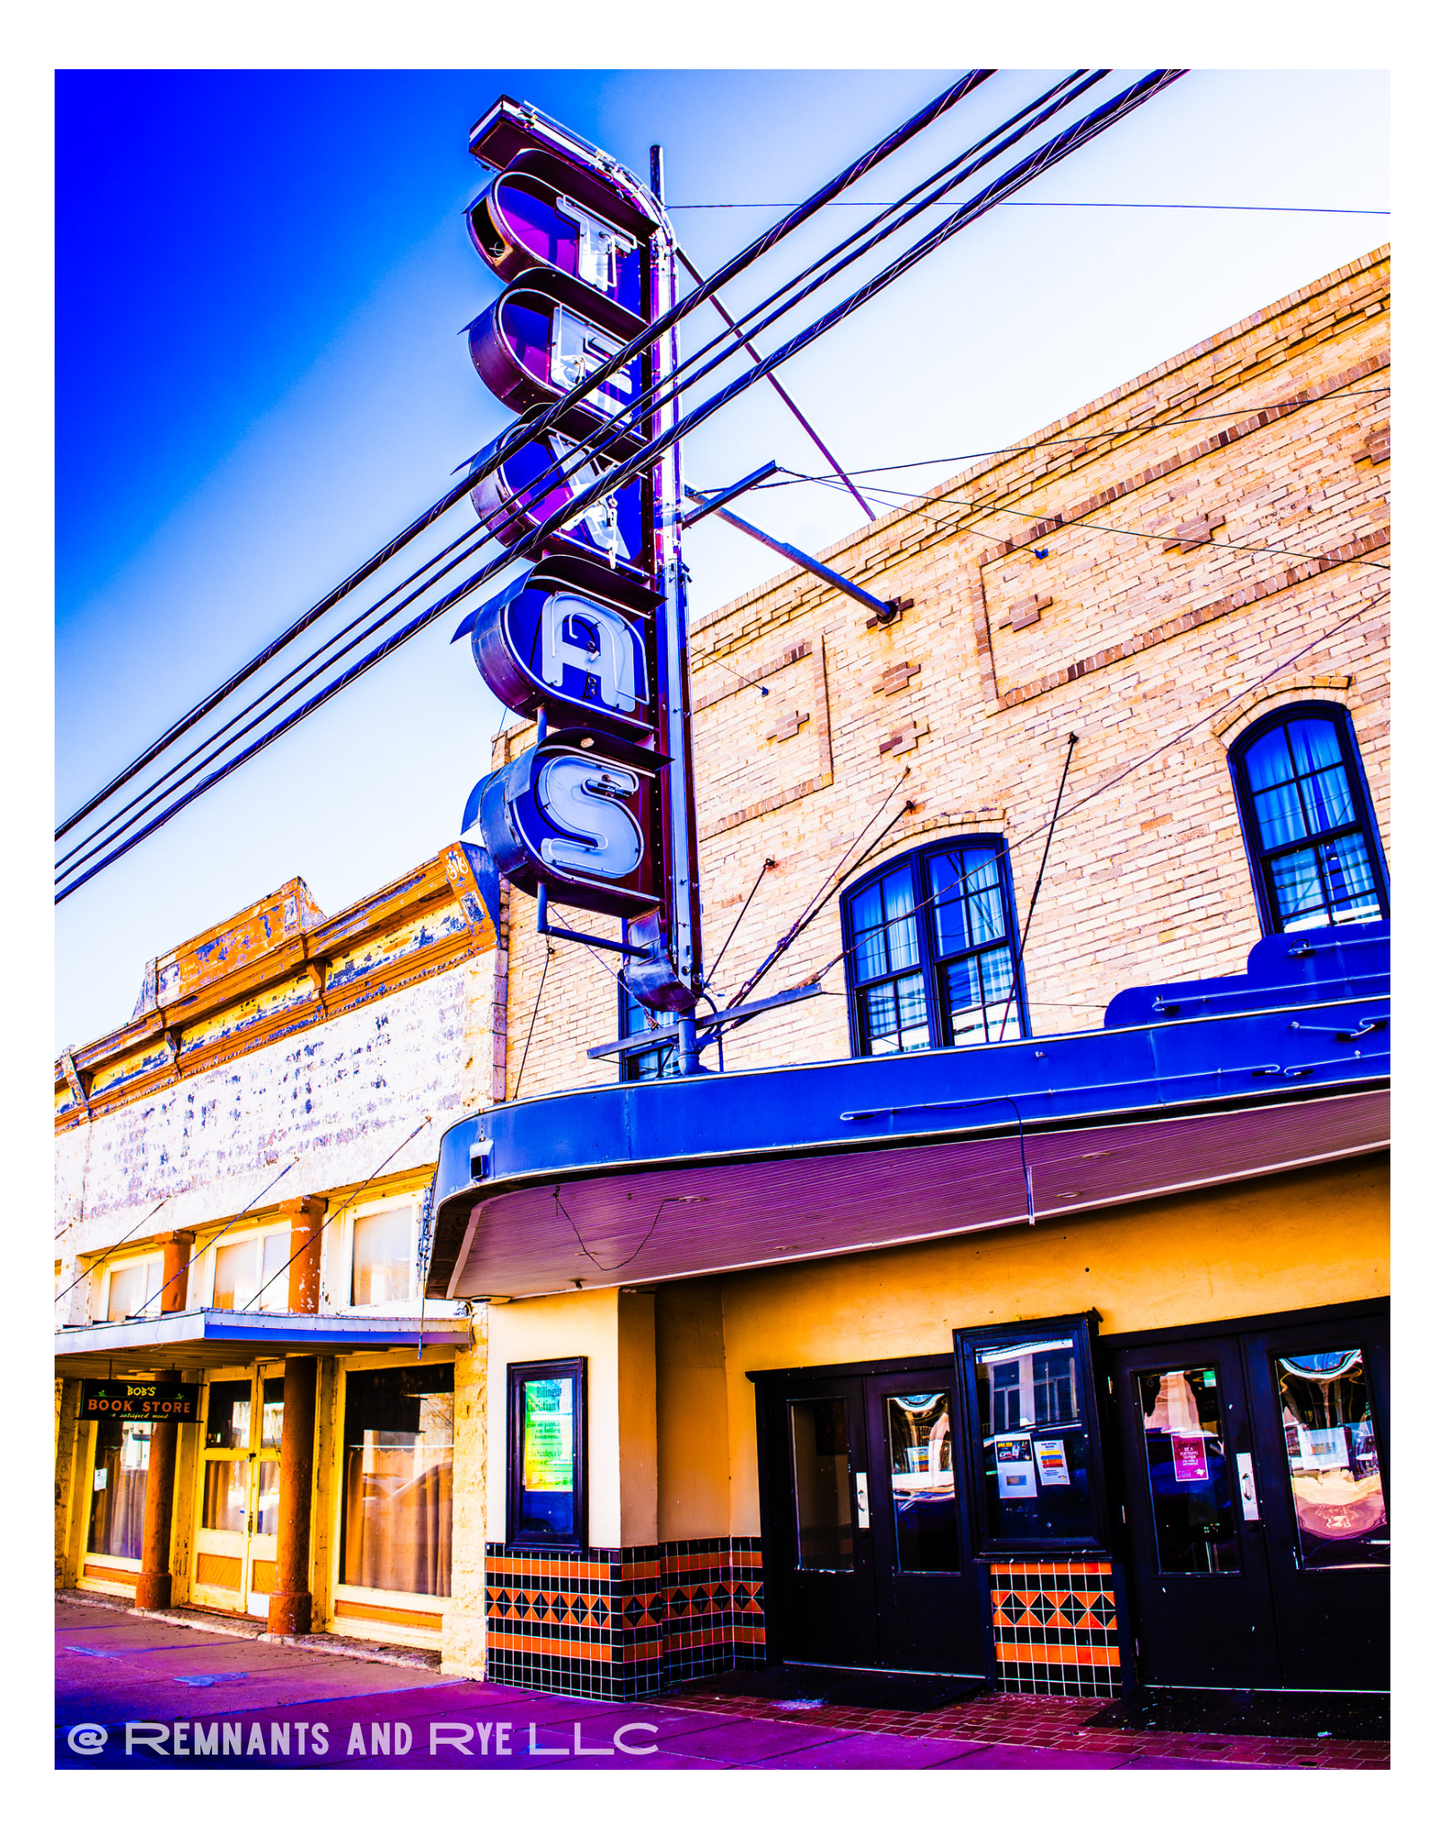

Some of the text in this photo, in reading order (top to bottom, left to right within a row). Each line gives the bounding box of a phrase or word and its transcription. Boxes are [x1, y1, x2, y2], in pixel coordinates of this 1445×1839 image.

[539, 193, 649, 879] TEXAS
[126, 1384, 156, 1397] BOB'S
[88, 1399, 191, 1413] BOOK STORE
